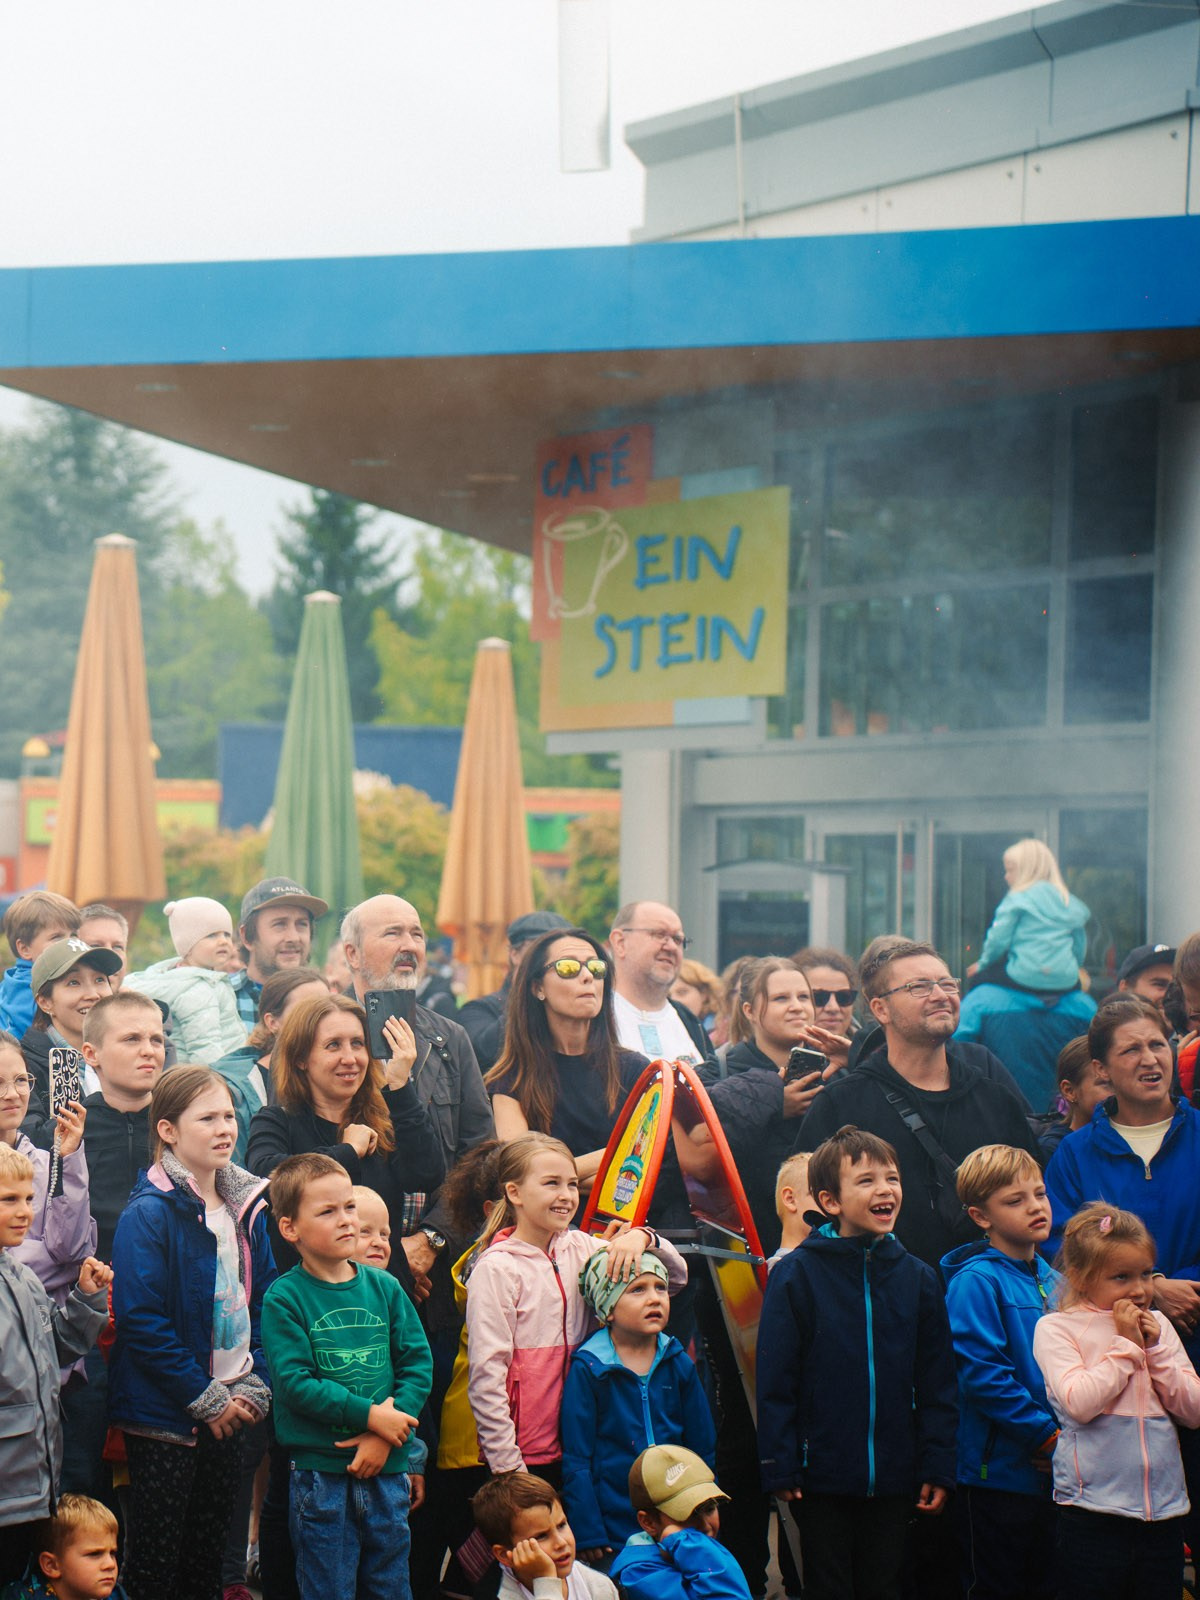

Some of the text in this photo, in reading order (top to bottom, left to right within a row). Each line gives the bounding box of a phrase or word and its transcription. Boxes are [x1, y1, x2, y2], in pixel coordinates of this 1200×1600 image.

[541, 434, 632, 498] CAFÉ
[634, 525, 742, 590] EIN
[593, 606, 765, 679] STEIN
[666, 1462, 686, 1479] NIKE
